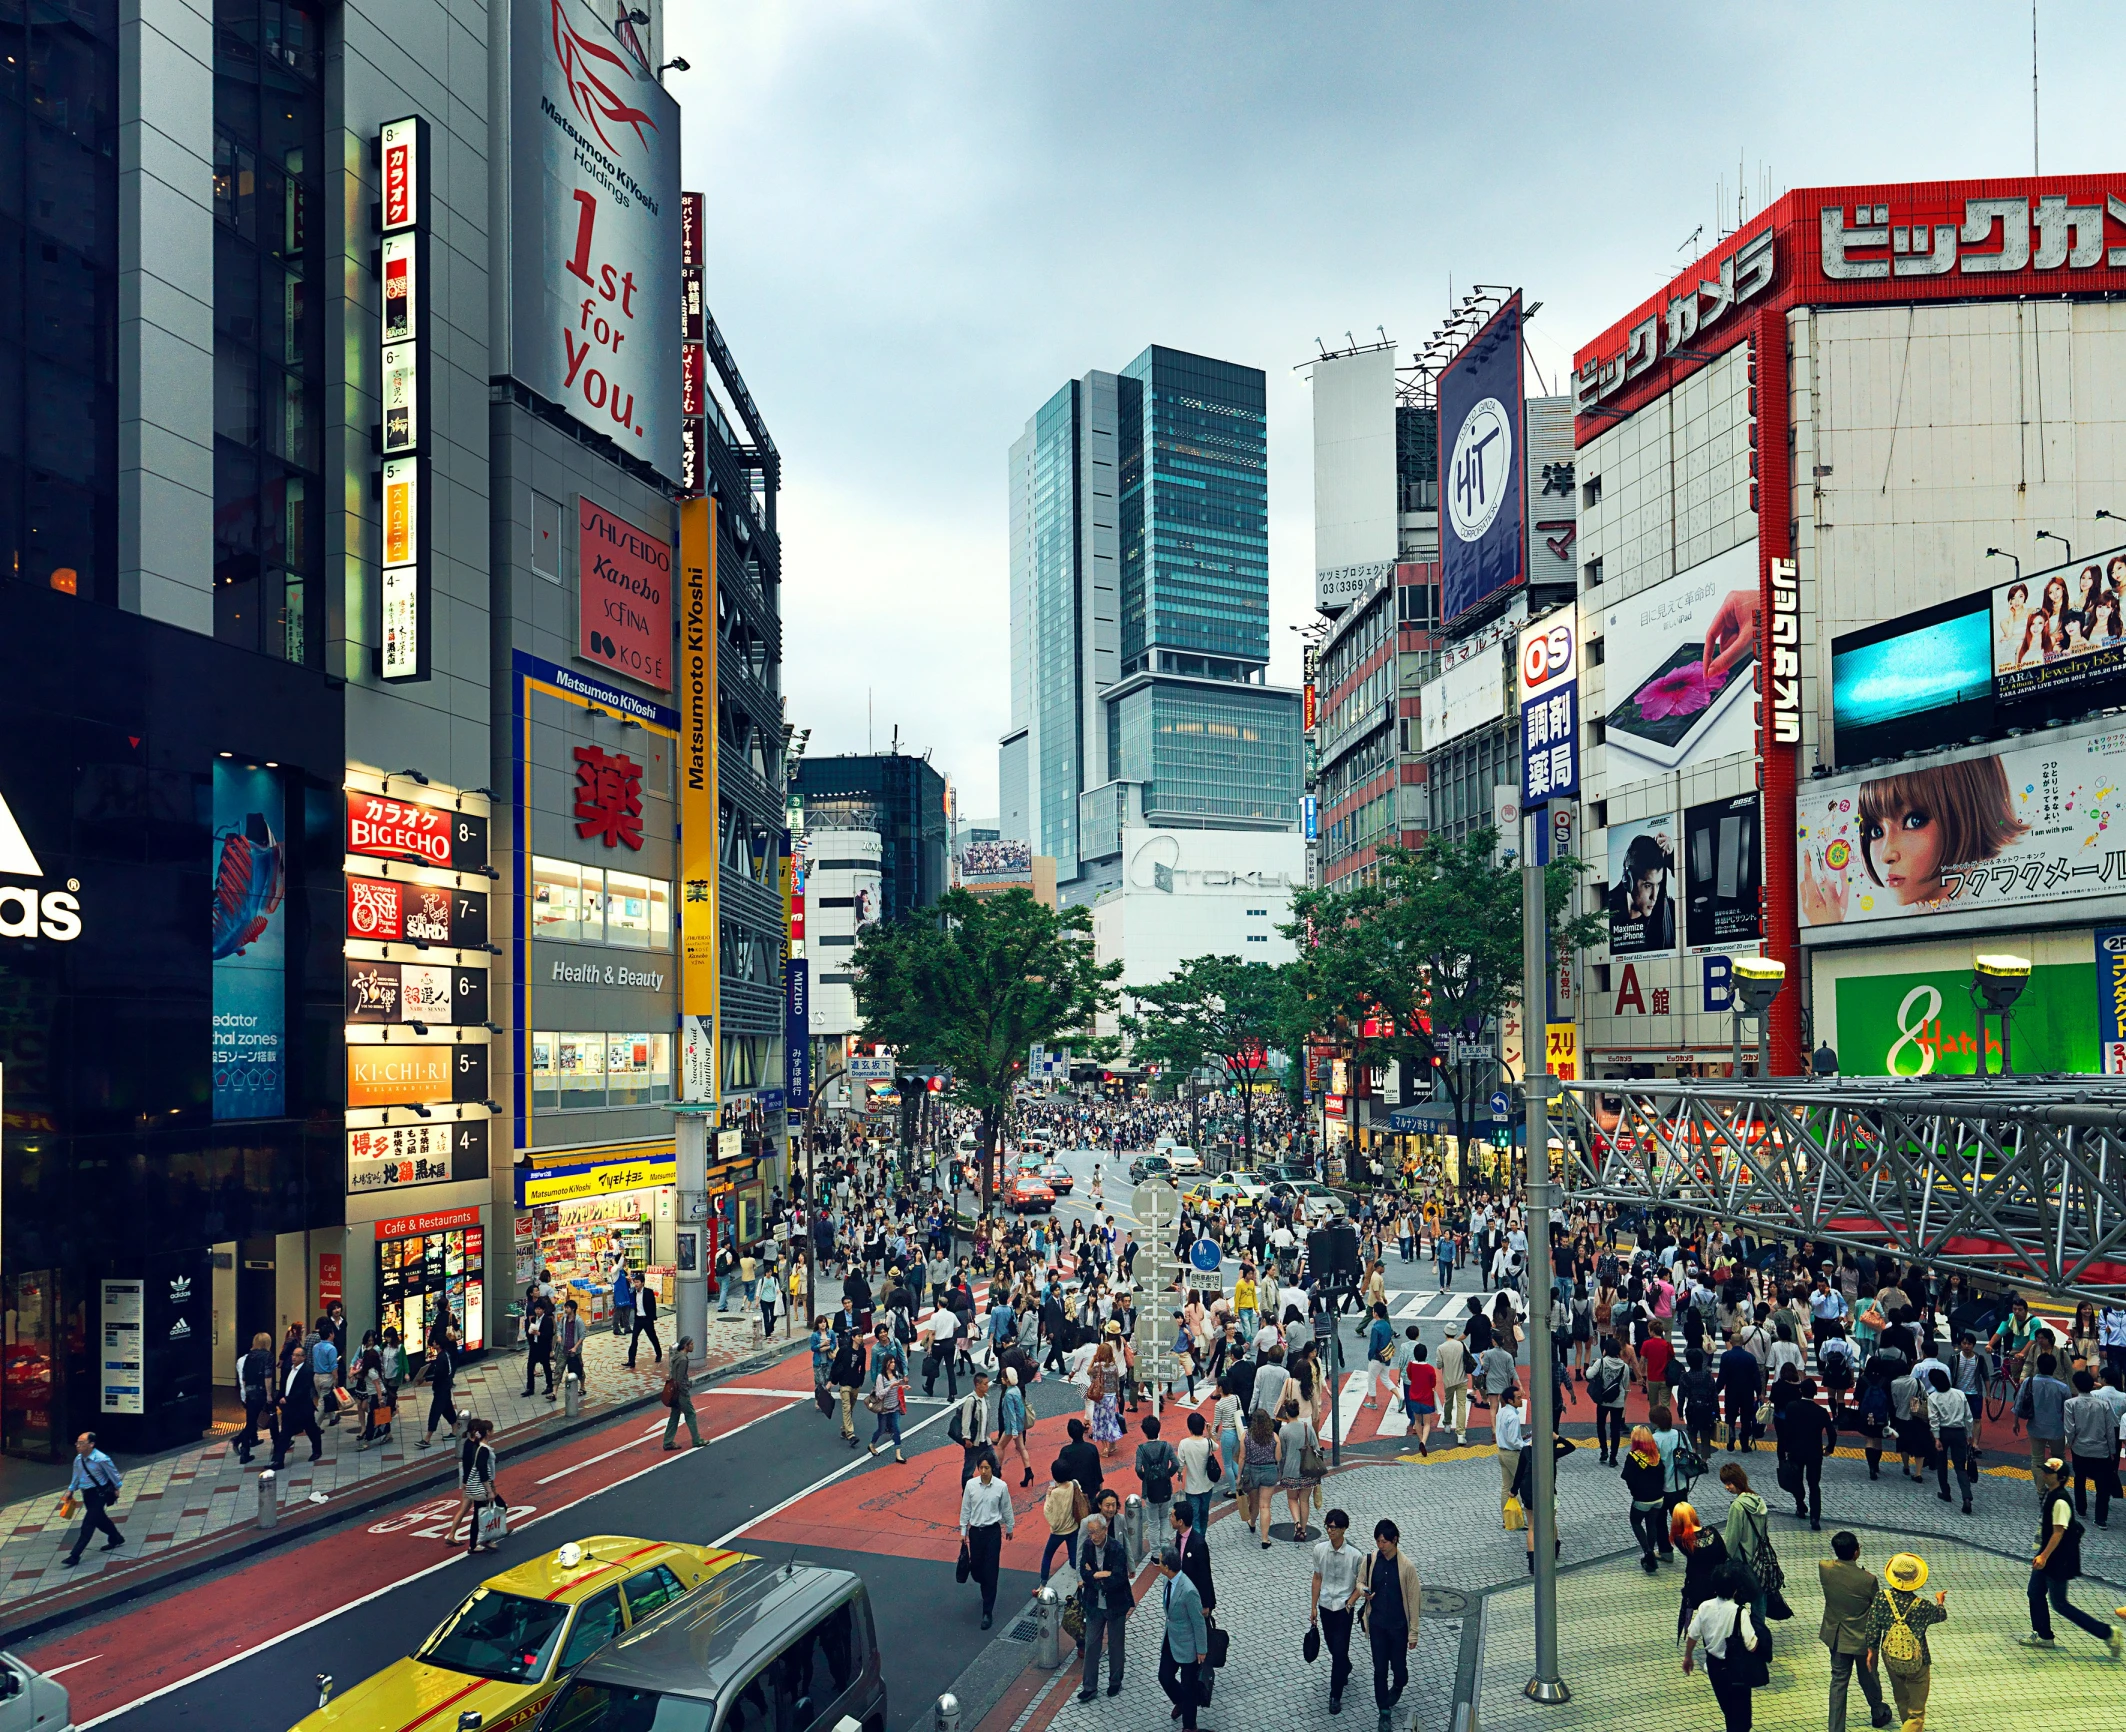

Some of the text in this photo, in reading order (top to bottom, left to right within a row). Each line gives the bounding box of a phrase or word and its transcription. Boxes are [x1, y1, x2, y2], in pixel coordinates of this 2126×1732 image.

[541, 96, 659, 217] Matsumoto KiYoshi
[390, 150, 405, 221] カラオケ
[573, 147, 630, 209] Holdings
[566, 188, 638, 320] 1st
[581, 298, 625, 356] for
[1570, 225, 1776, 417] ビックカメラ
[563, 327, 644, 438] you.
[581, 513, 670, 572] SHISEIDO
[593, 554, 660, 605] Kanebo
[1639, 581, 1717, 627] 目に見えて革命的
[620, 645, 662, 679] KOSÉ
[1525, 625, 1573, 688] OS
[1771, 556, 1800, 743] ビックカメラ
[688, 567, 704, 790] KiYoshi Matsumoto
[1998, 670, 2034, 687] T-ARA
[2036, 651, 2120, 684] Jewelry box
[556, 671, 656, 720] Matsumoto KiYoshi
[2017, 685, 2036, 694] JAPAN
[2037, 681, 2052, 690] LIVE
[2052, 677, 2070, 687] TOUR
[1527, 690, 1571, 751] 調剤
[1528, 742, 1572, 798] 薬局
[573, 745, 645, 852] 薬
[366, 799, 439, 831] カラオケ
[2046, 826, 2060, 836] with
[2061, 825, 2075, 834] you.
[351, 818, 450, 860] BIG ECHO
[686, 879, 708, 903] 薬
[1613, 923, 1644, 934] Maximize
[552, 961, 664, 992] Health & Beauty
[793, 970, 804, 1015] MIZUHO
[238, 1034, 278, 1045] zones
[700, 1019, 712, 1029] 4F
[850, 1060, 891, 1070] 道玄坂下
[1666, 1054, 1694, 1062] ビックカメラ
[352, 1131, 389, 1159] 博多
[393, 1130, 403, 1156] 串焼き
[407, 1129, 416, 1155] もつ鍋
[420, 1128, 430, 1154] 芋焼酎
[530, 1182, 592, 1200] Matsumoto KiYoshi
[384, 1211, 471, 1235] Café & Restaurants
[320, 1279, 341, 1288] Restaurants
[324, 1264, 337, 1273] Café
[170, 1290, 192, 1300] adidas
[510, 1702, 543, 1727] TAXI
